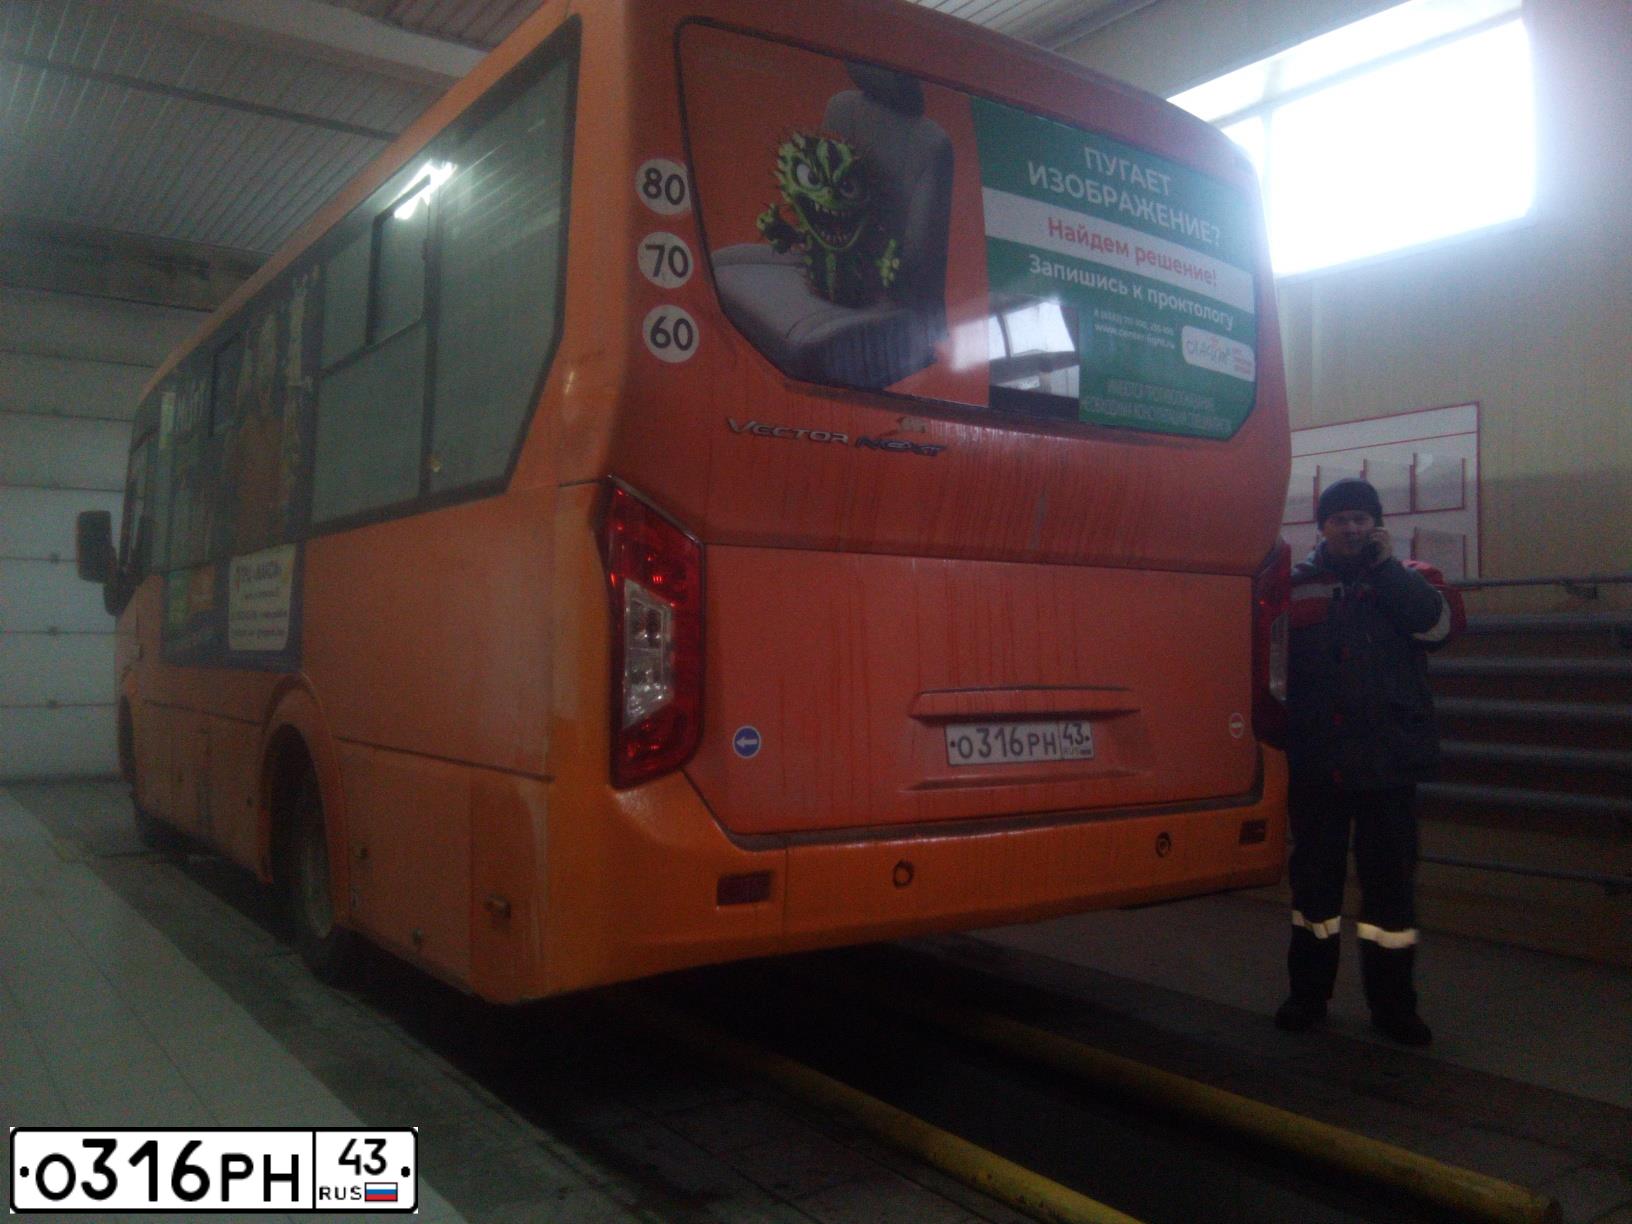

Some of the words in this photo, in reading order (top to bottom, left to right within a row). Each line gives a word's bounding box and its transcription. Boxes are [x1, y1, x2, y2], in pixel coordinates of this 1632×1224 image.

[643, 167, 685, 205] 80
[1083, 146, 1172, 197] ПУГАЕТ
[1027, 160, 1221, 248] ИЗОБРАЖЕНИЕ?
[645, 244, 689, 278] 70
[1047, 216, 1130, 257] Найдем
[1135, 246, 1217, 288] решение!
[1028, 253, 1128, 296] Запишись
[1132, 283, 1142, 300] к
[1147, 287, 1234, 332] проктологу
[650, 315, 694, 350] 60
[727, 416, 850, 444] VECTOR
[1061, 721, 1085, 747] 43
